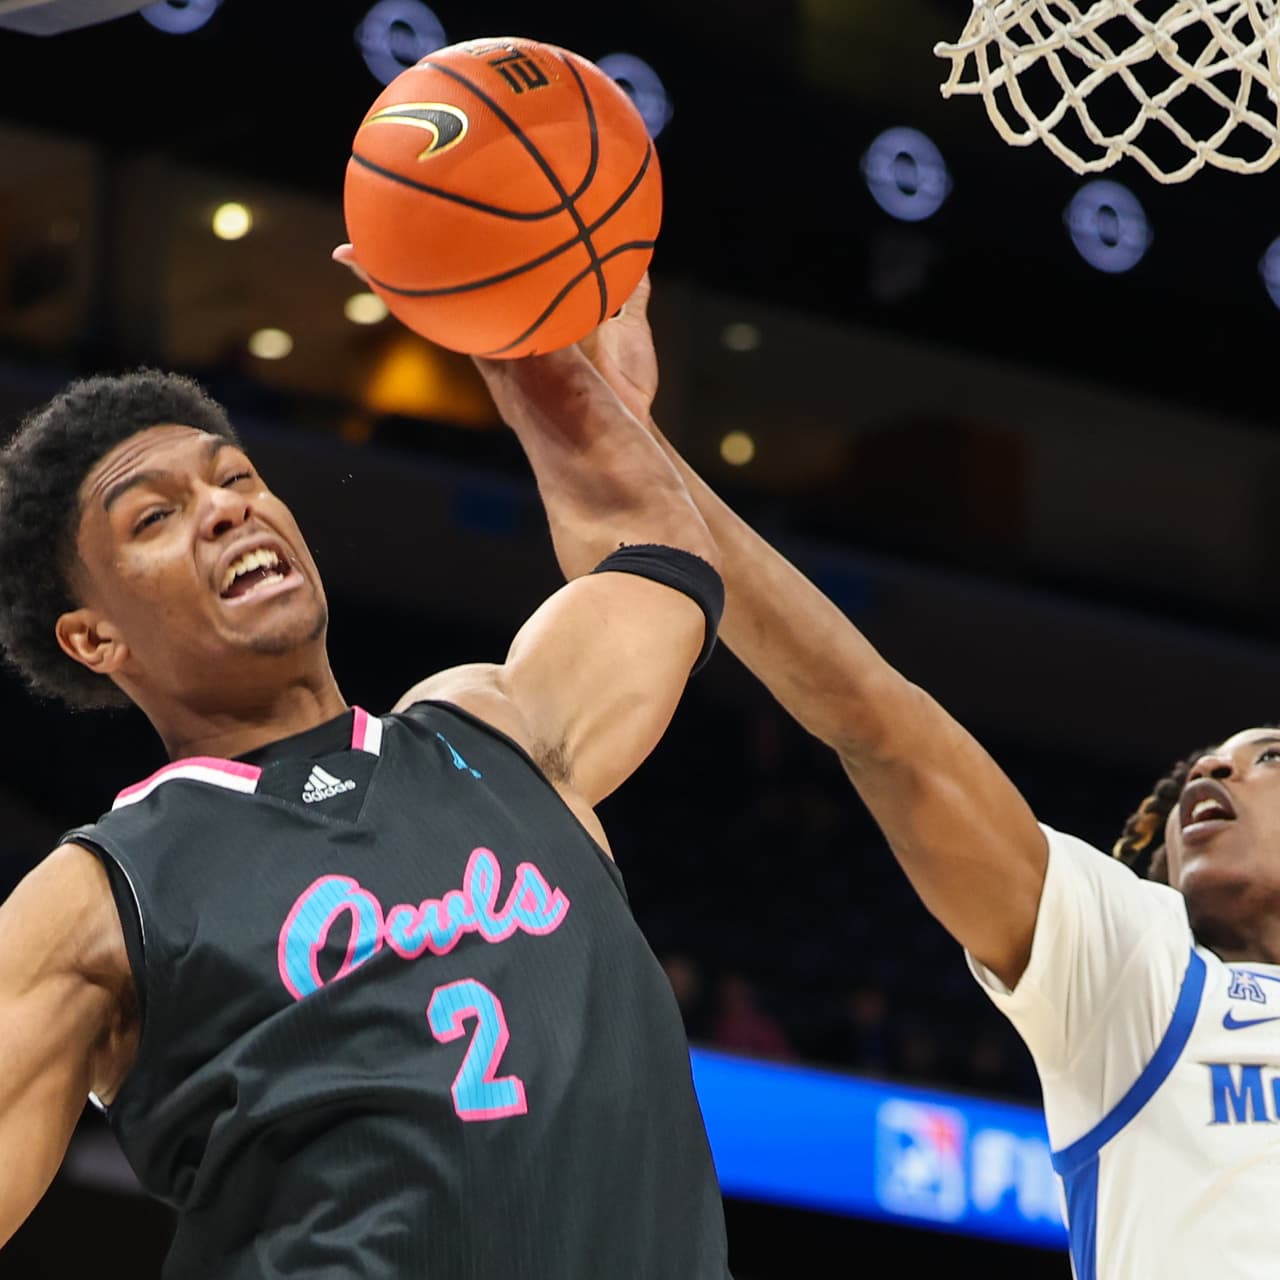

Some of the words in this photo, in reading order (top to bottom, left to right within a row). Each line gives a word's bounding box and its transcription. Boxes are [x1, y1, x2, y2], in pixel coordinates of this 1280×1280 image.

[302, 779, 356, 803] adidas
[278, 847, 570, 1001] Owls
[427, 978, 528, 1122] 2
